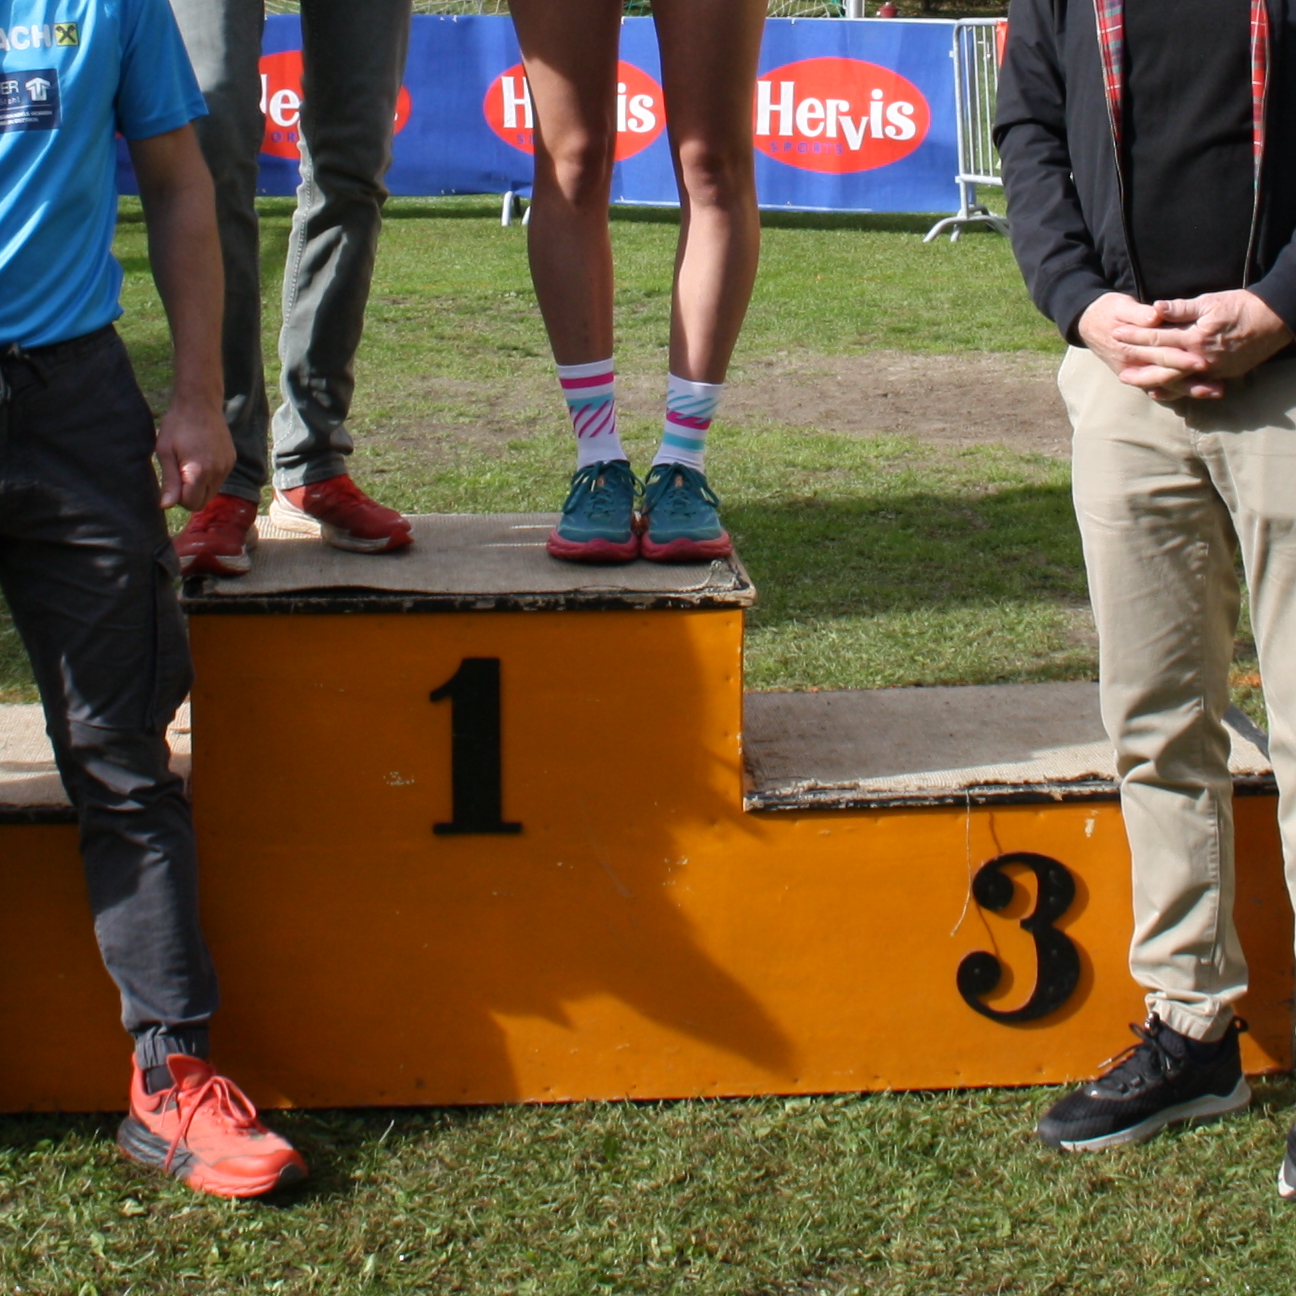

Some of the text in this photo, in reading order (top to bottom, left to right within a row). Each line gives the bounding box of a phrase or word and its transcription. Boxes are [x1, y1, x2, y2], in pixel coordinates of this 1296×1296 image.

[755, 80, 917, 151] Hervis
[769, 141, 845, 156] SPORTS
[429, 656, 523, 836] 1
[956, 851, 1081, 1023] 3
